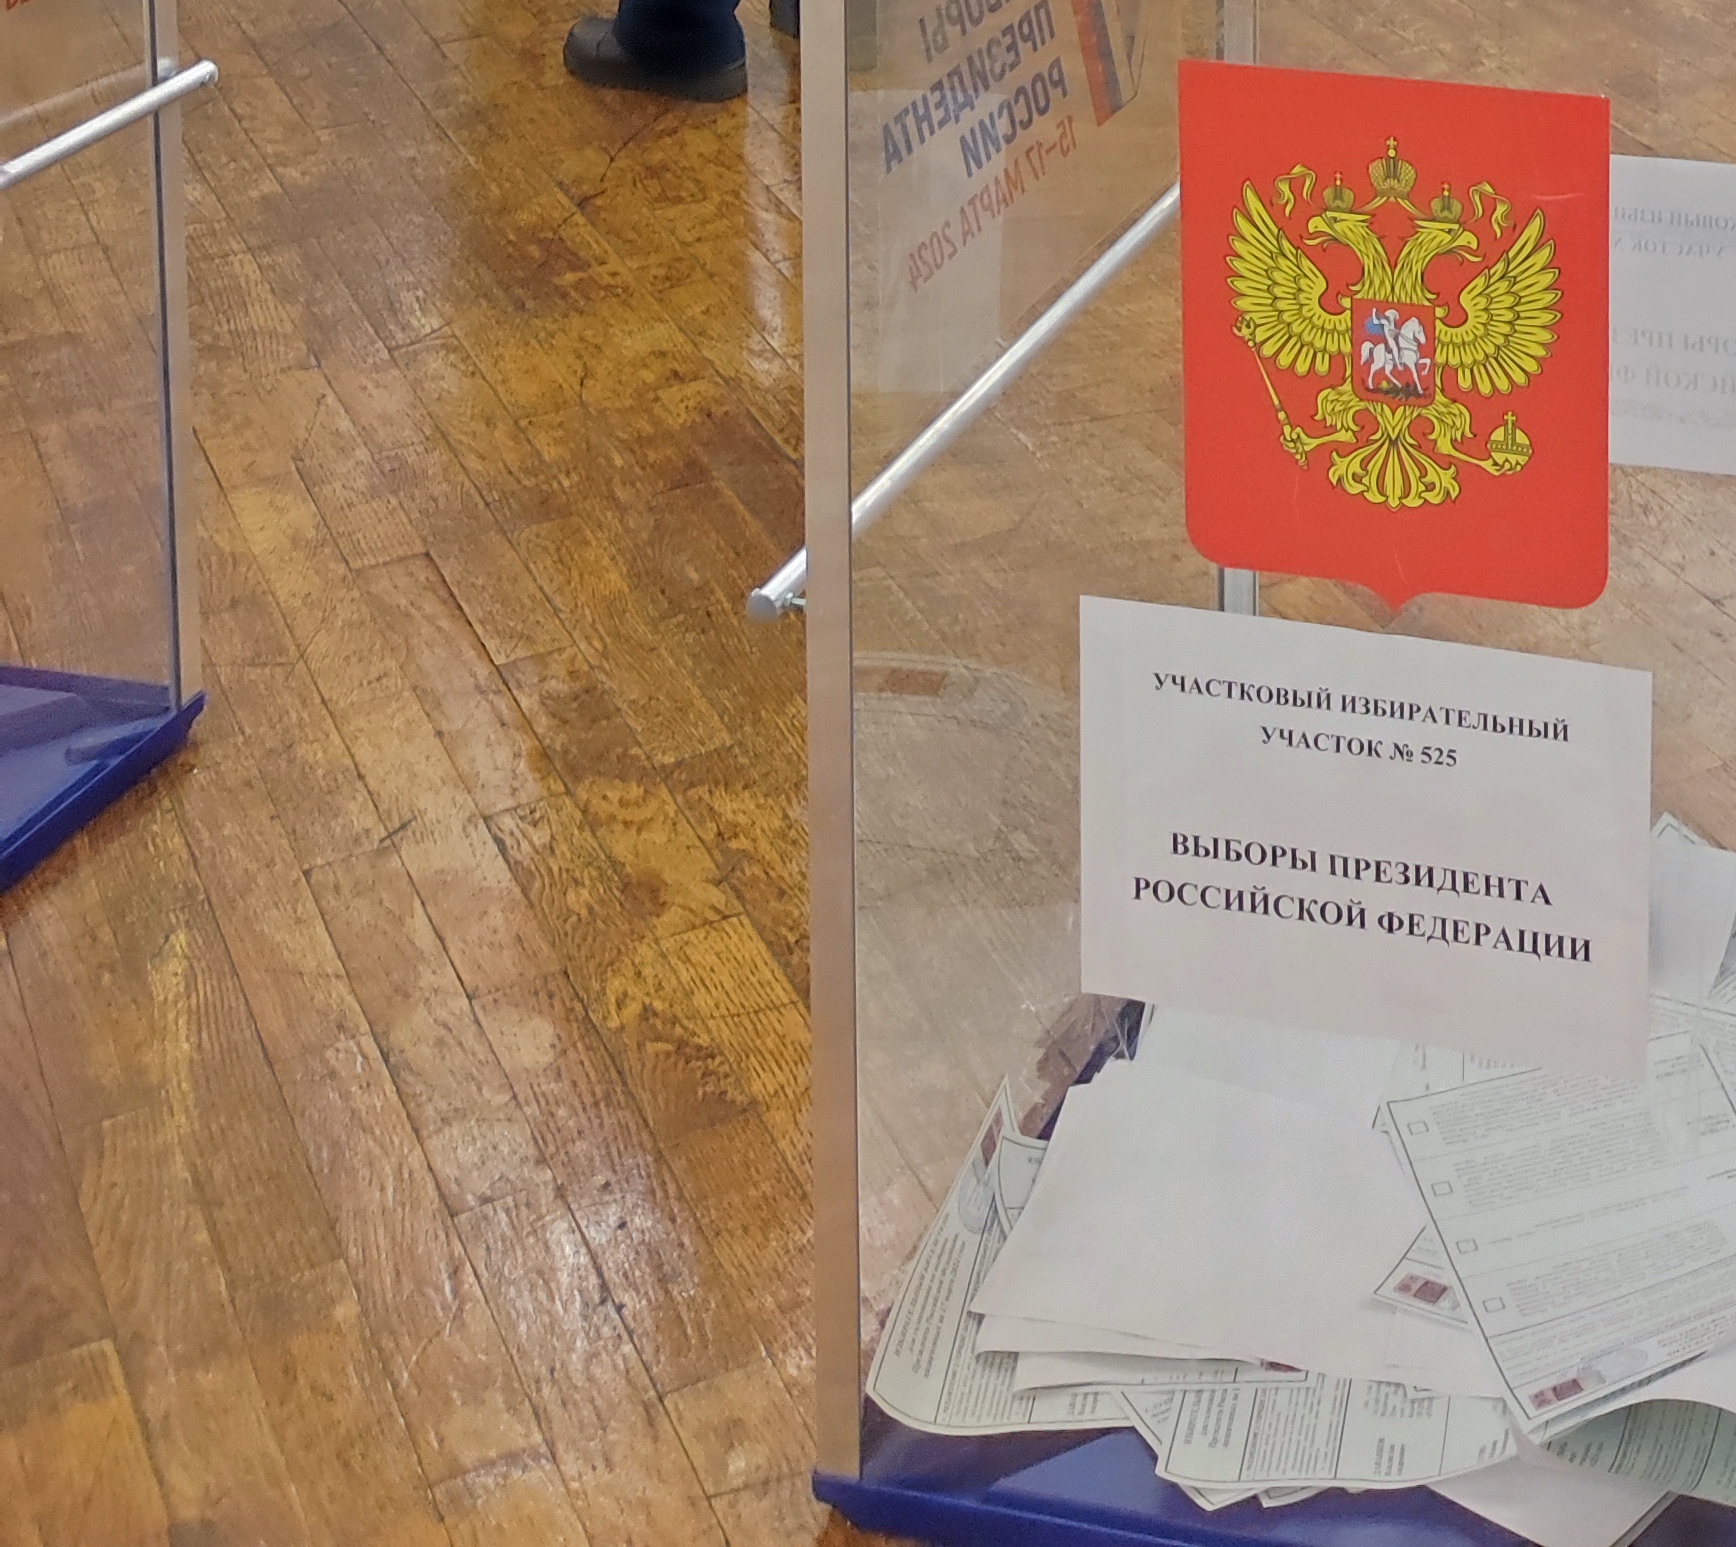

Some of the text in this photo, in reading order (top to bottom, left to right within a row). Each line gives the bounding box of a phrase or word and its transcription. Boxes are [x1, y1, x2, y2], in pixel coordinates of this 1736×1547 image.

[1152, 671, 1571, 743] УЧАСТКОВЫЙ ИЗБИРАТЕЛЬНЫЙ
[1259, 724, 1459, 768] УЧАСТОК № 525
[1169, 830, 1553, 907] ВЫБОРЫ ПРЕЗИДЕНТА
[1132, 875, 1594, 964] РОССИЙСКОЙ ФЕДЕРАЦИИ
